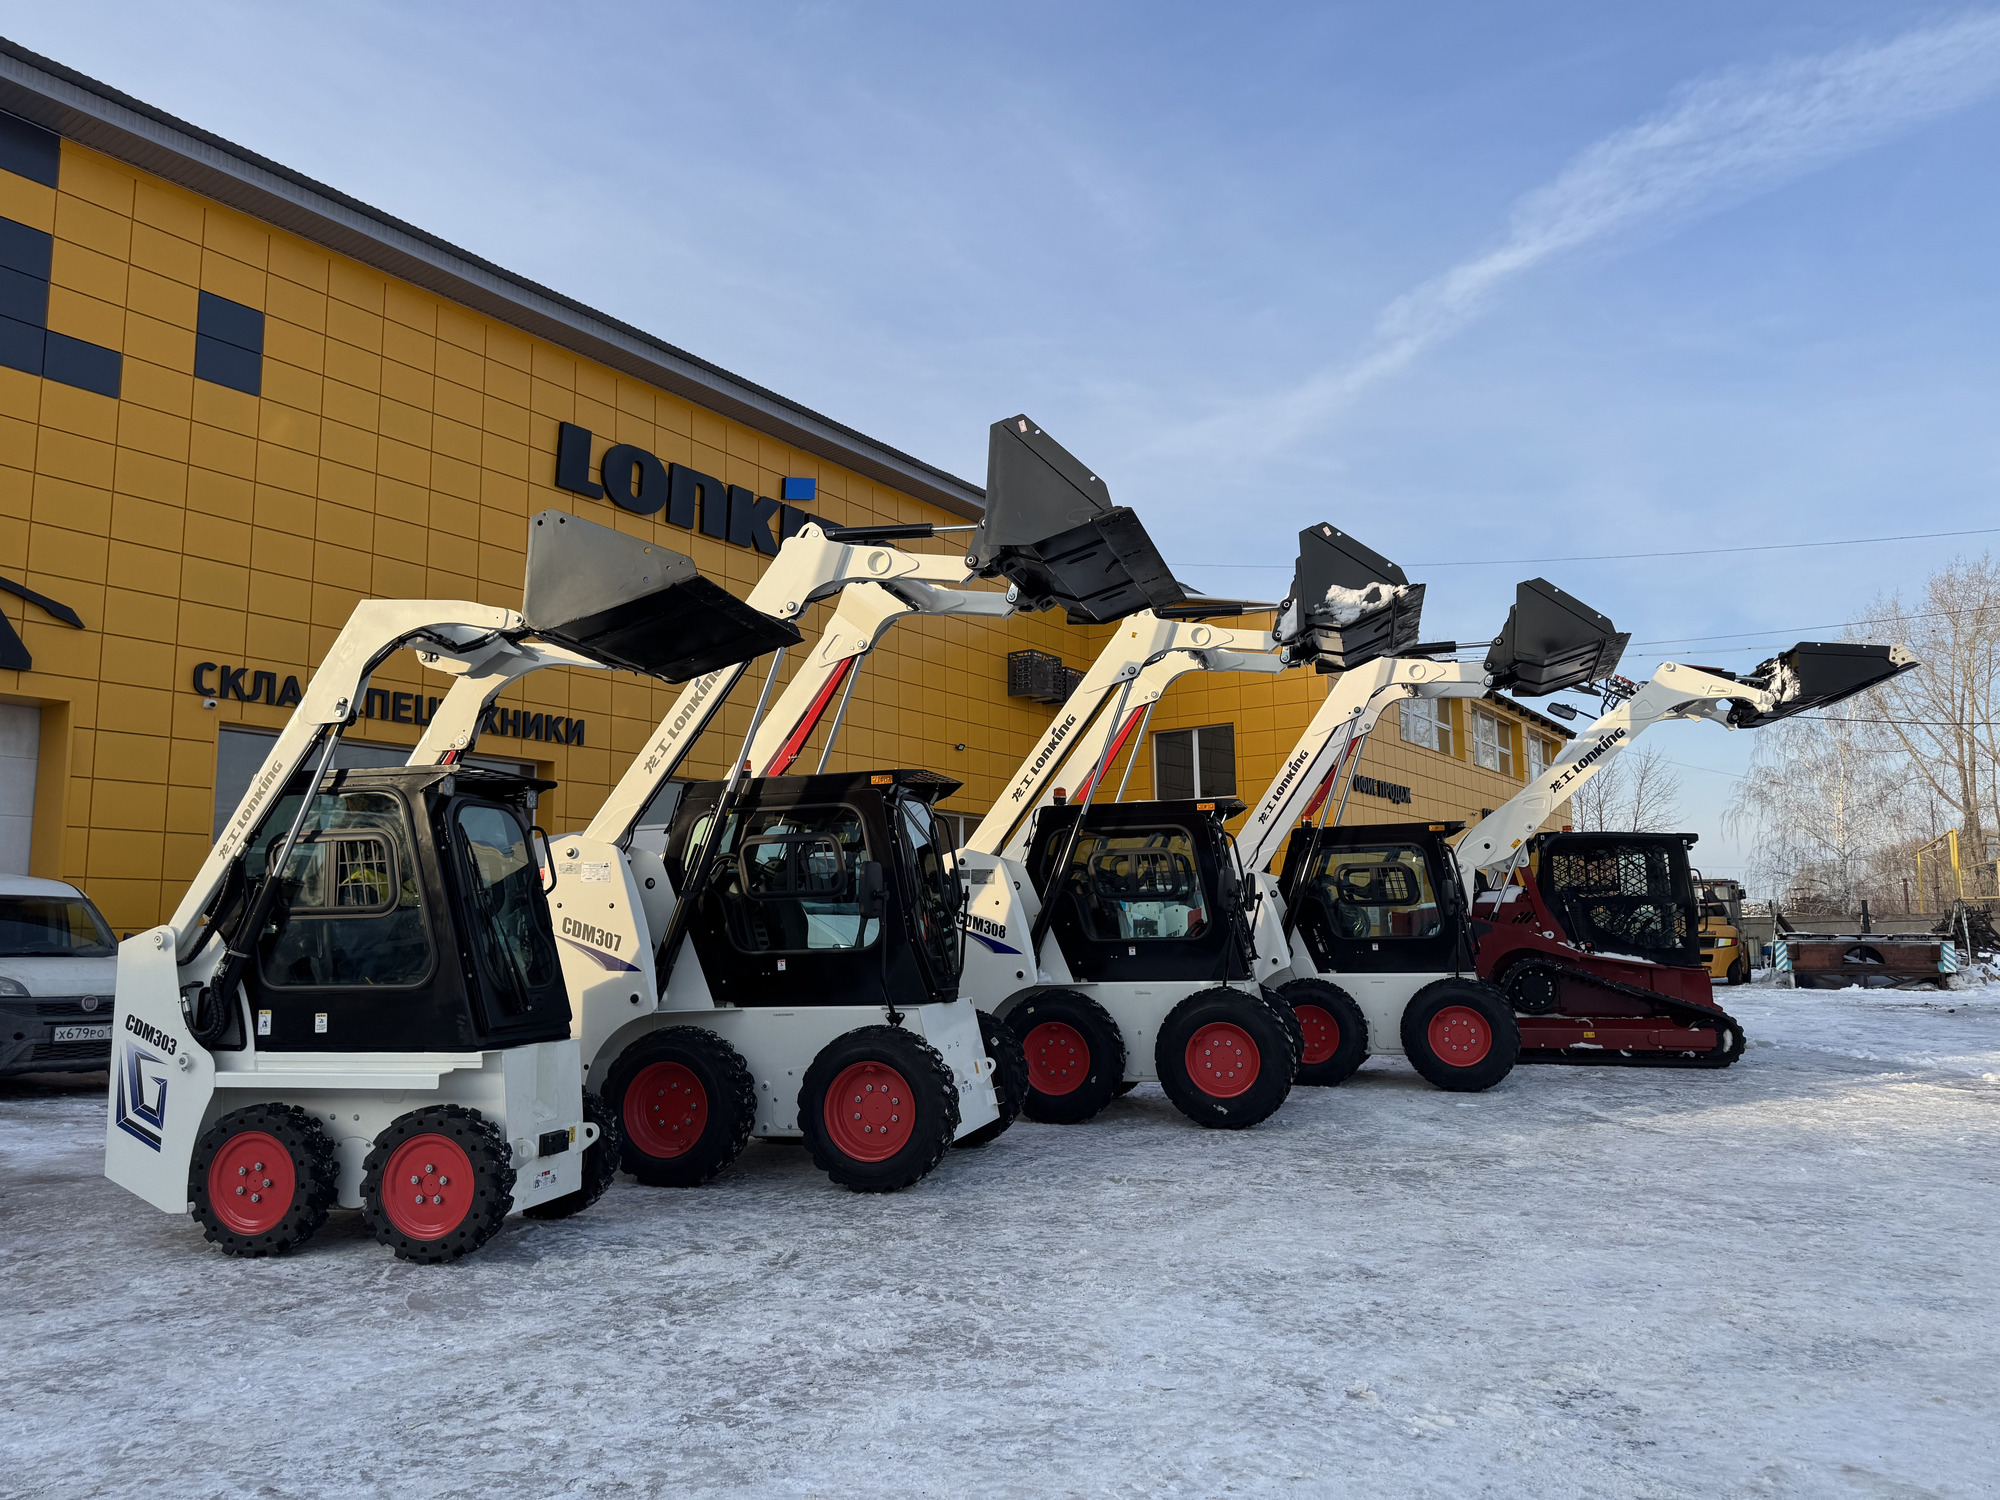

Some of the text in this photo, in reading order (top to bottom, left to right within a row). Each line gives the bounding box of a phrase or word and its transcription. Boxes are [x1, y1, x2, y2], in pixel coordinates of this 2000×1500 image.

[193, 662, 304, 706] СКЛА
[1353, 774, 1412, 805] ОФИС ПРОДАЖ
[562, 917, 622, 952] CDM307
[125, 1014, 177, 1056] CDM303
